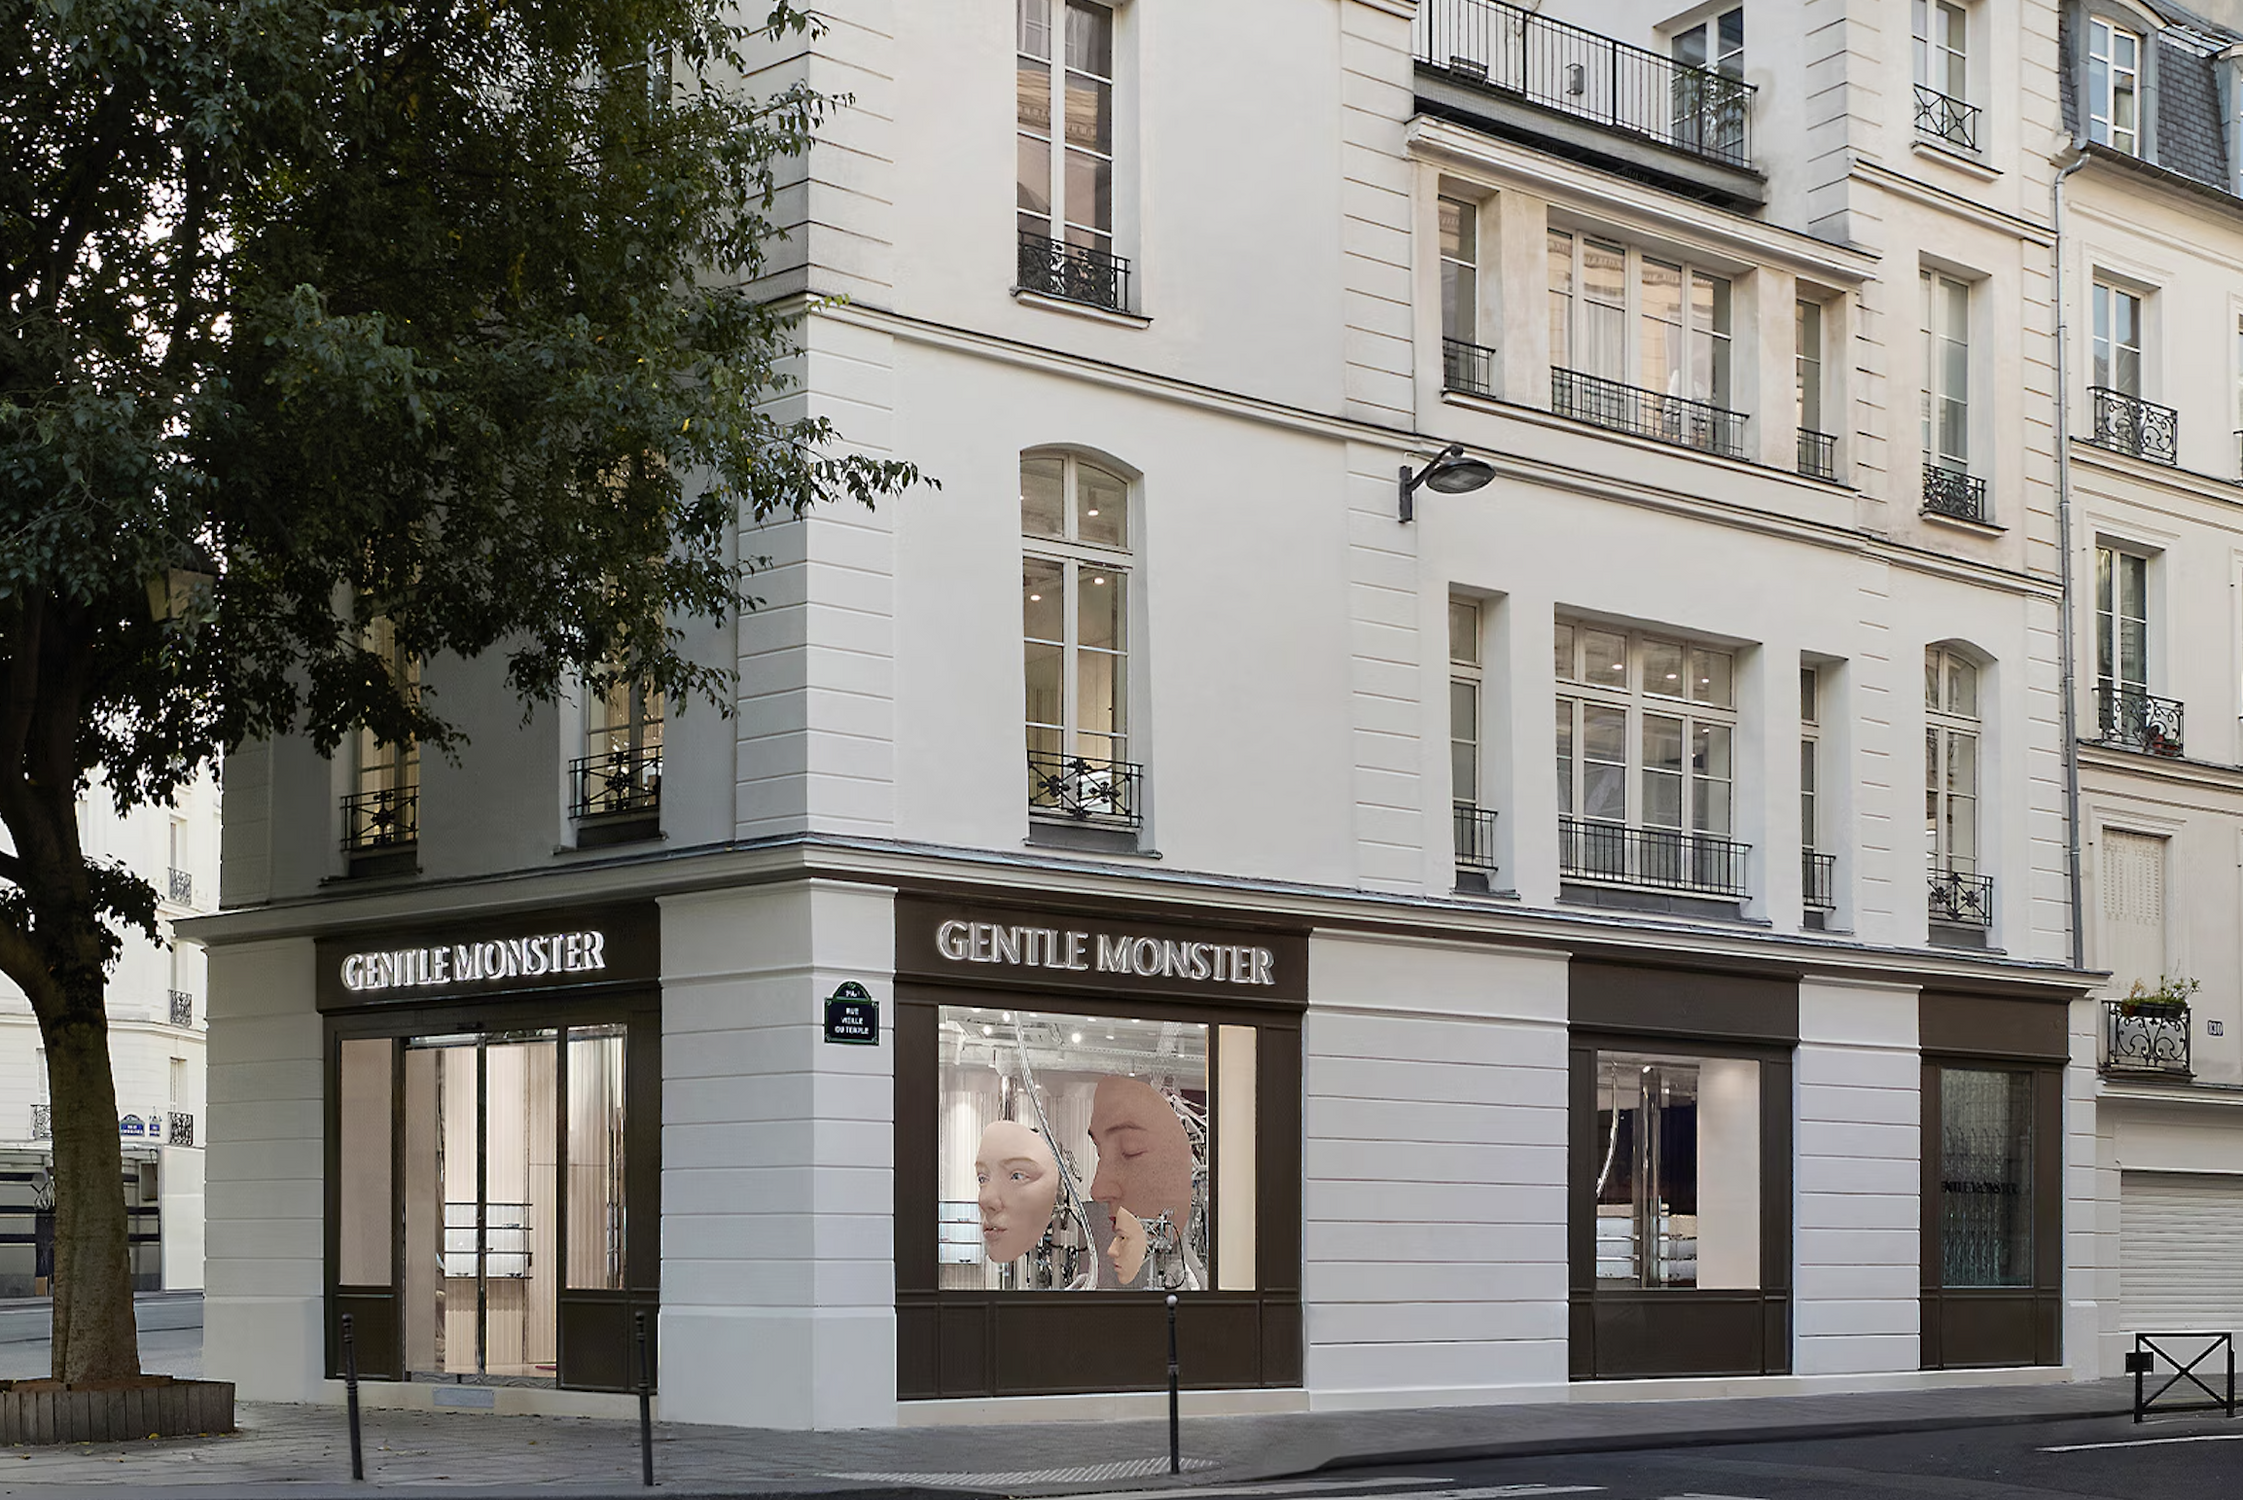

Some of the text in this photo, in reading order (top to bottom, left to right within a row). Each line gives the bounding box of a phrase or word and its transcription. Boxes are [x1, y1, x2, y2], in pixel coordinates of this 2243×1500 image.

[340, 930, 606, 991] GENTLE MONSTER
[937, 919, 1275, 986] GENTLE MONSTER
